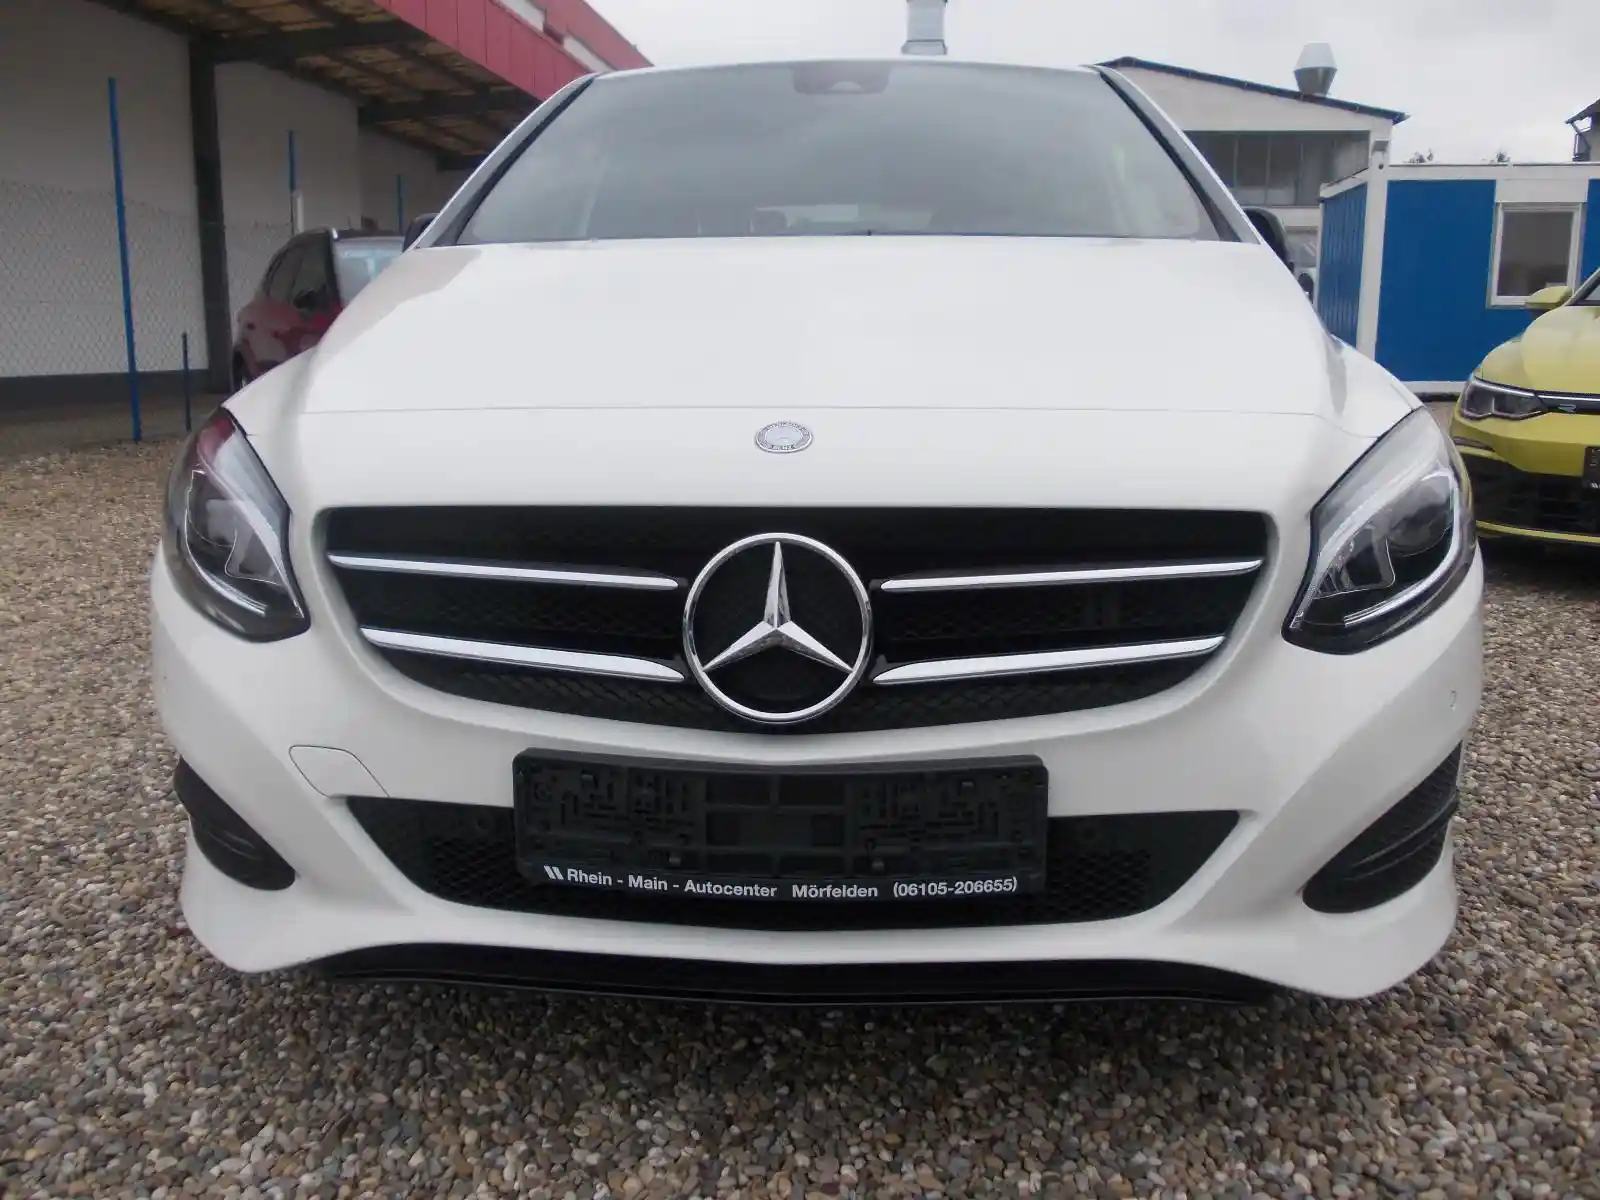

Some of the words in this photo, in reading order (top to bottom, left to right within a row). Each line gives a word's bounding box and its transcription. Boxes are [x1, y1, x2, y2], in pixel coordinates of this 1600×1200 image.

[567, 868, 612, 886] Rhein
[628, 874, 668, 891] Main
[684, 879, 777, 897] Autocenter
[792, 884, 878, 898] Mörfelden
[893, 876, 1018, 898] (06105-206655)
